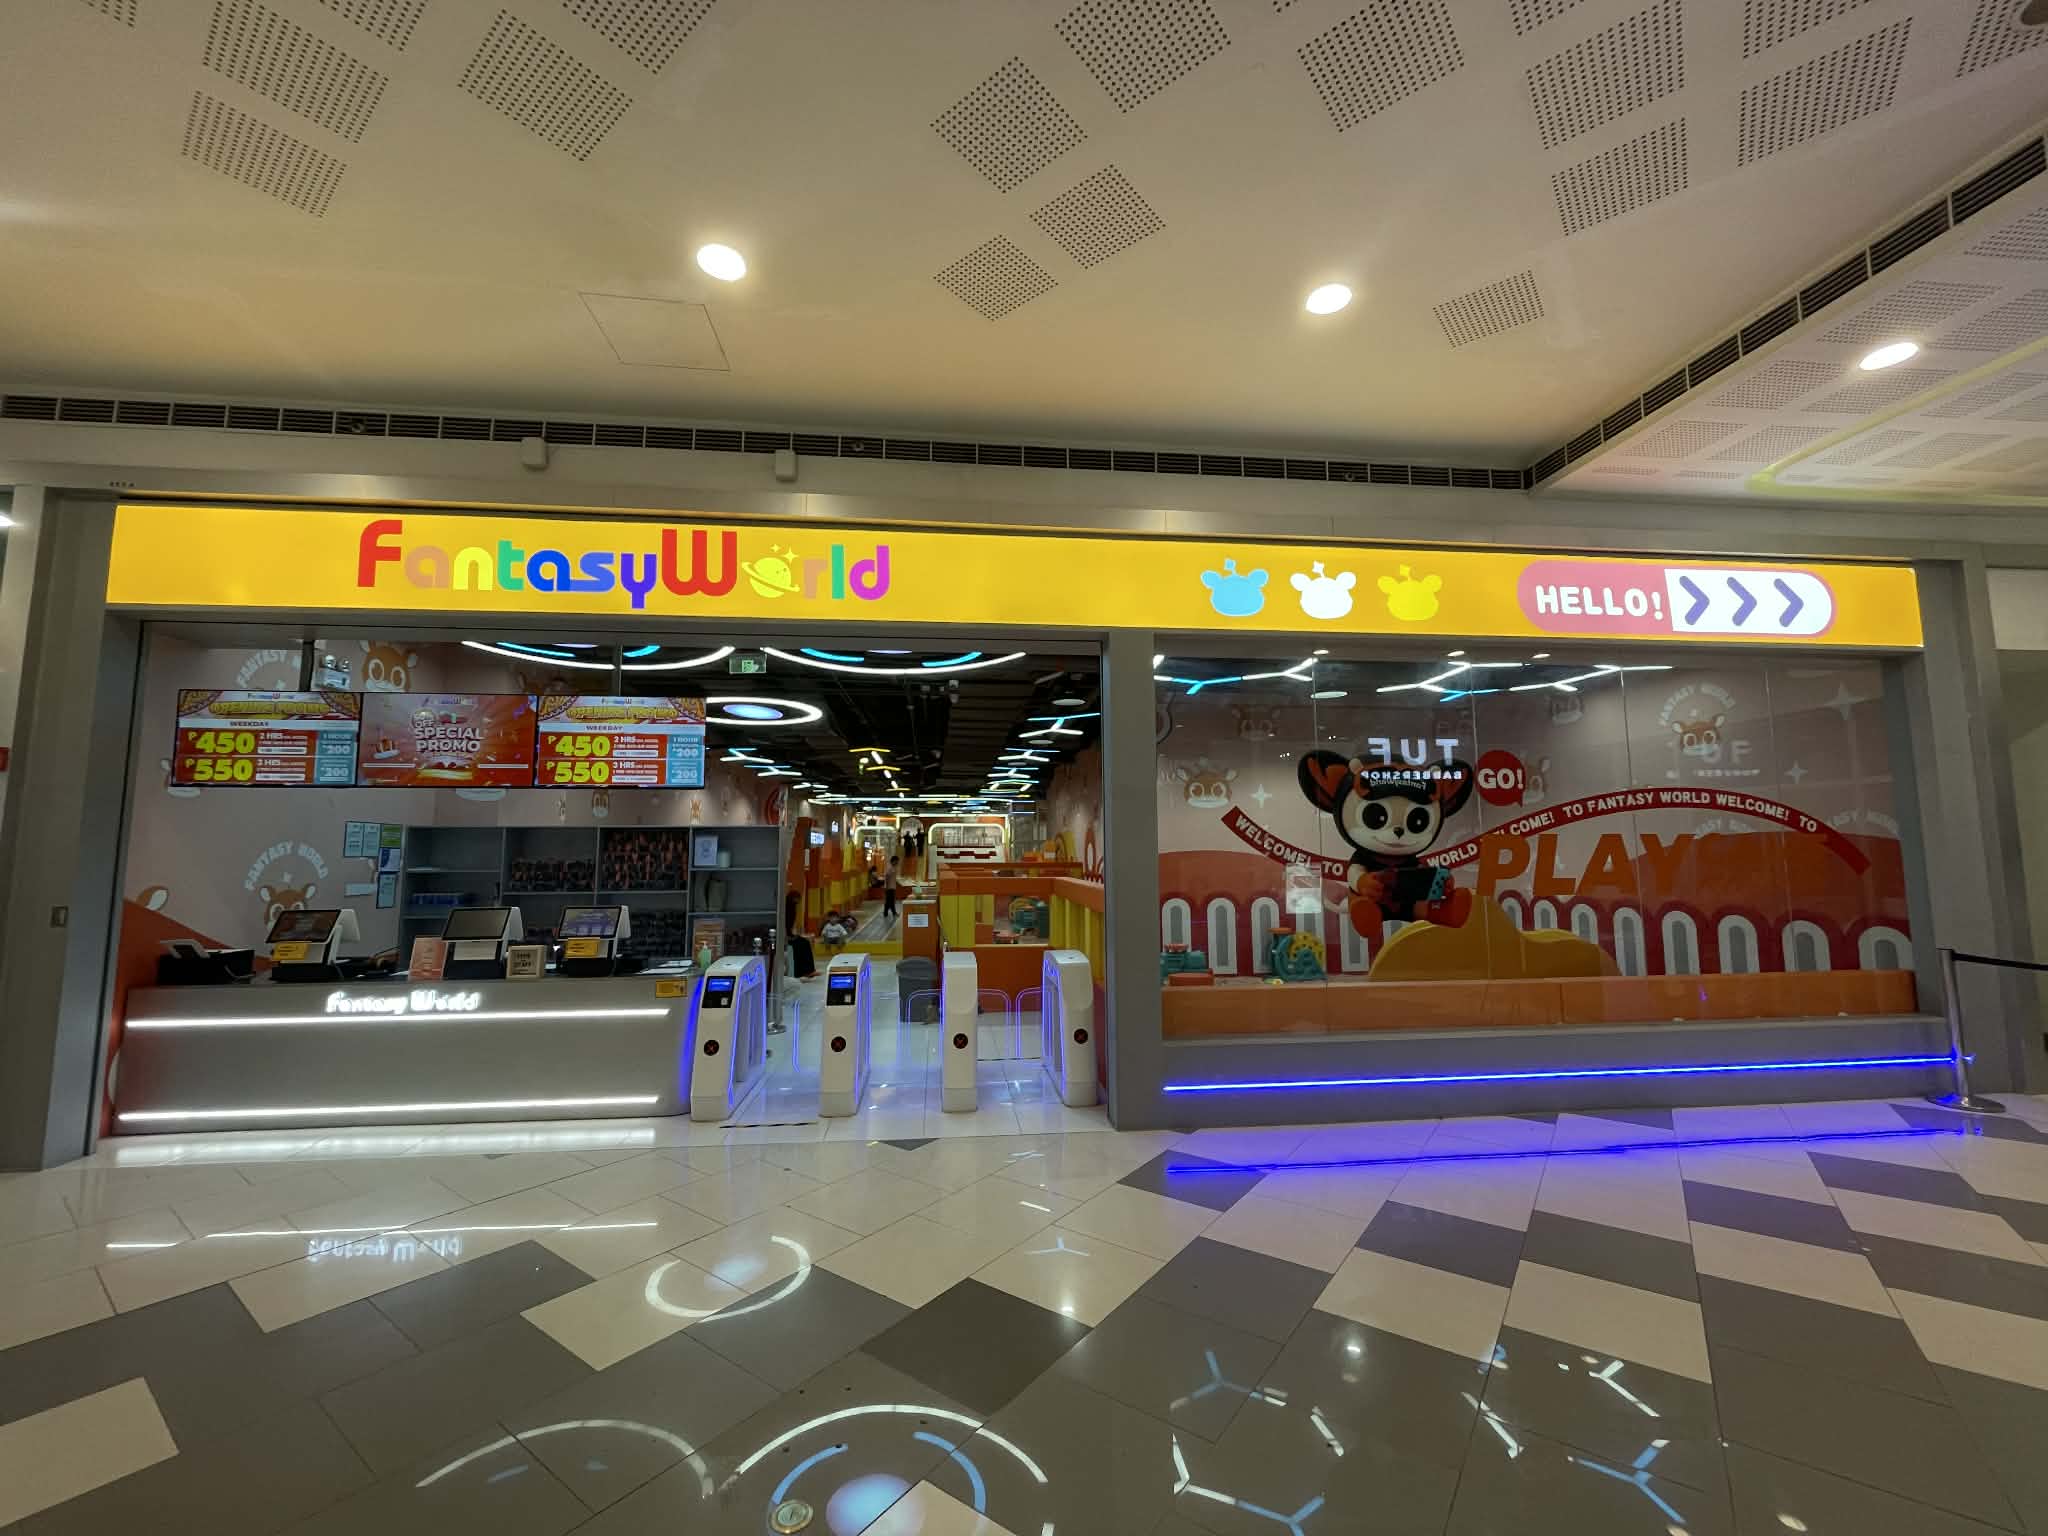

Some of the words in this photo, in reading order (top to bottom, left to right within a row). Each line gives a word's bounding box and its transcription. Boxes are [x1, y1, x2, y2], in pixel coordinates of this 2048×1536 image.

[1535, 584, 1664, 620] HELLO!
[414, 727, 483, 740] SPECIAL
[416, 740, 480, 752] PROMO
[1477, 768, 1524, 789] GO!
[1235, 815, 1312, 868] WELCOME!
[1323, 861, 1344, 876] TO
[1427, 843, 1478, 868] WORLD
[1562, 804, 1584, 819] TO
[1587, 792, 1654, 812] FANTASY
[1660, 791, 1710, 804] WORLD
[1716, 793, 1790, 821] WELCOME!
[1799, 815, 1818, 832] TO
